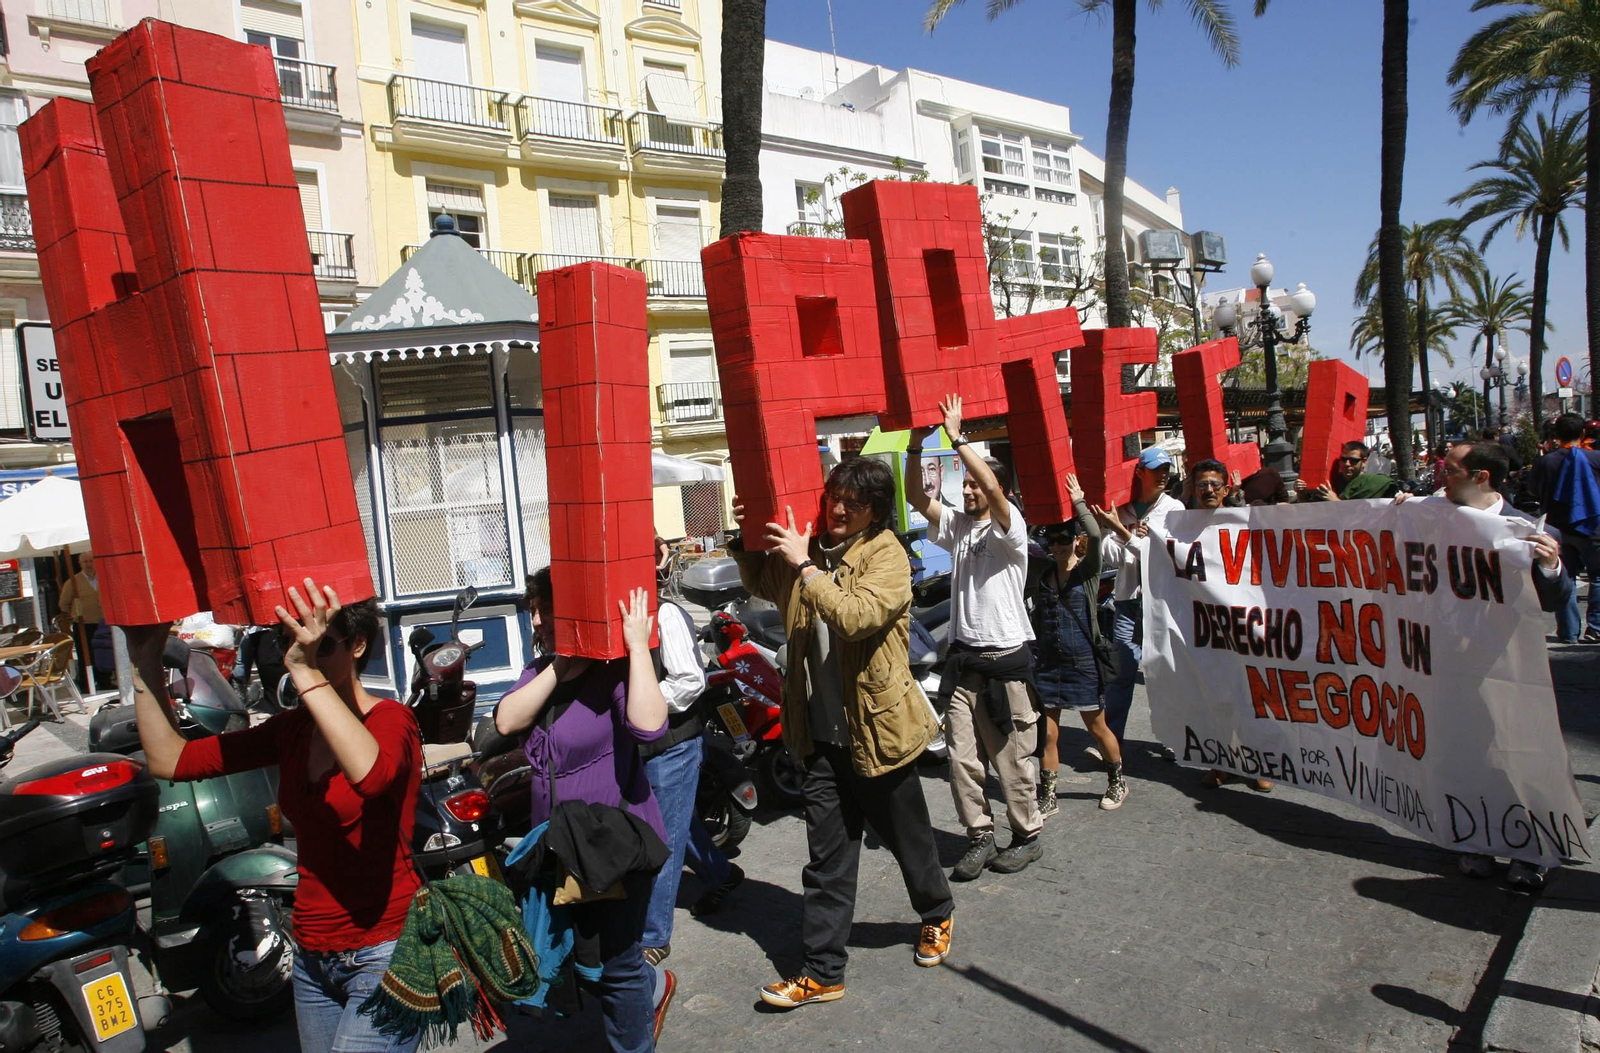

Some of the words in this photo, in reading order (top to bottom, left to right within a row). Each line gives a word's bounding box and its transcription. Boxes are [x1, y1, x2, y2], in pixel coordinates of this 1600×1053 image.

[1167, 539, 1206, 582] LA
[1218, 529, 1406, 596] VIVIENDA
[1404, 541, 1438, 595] ES
[1447, 544, 1504, 605] UN
[1193, 600, 1303, 661] DERECHO
[1316, 599, 1386, 668] NO
[1398, 618, 1431, 676] UN
[1245, 665, 1426, 760] NEGOCIO
[1183, 725, 1298, 785] ASAMBLEA
[1300, 747, 1330, 767] POR
[1301, 767, 1335, 789] UNA
[159, 800, 189, 813] espa
[96, 985, 115, 1001] C6
[96, 997, 124, 1017] 375
